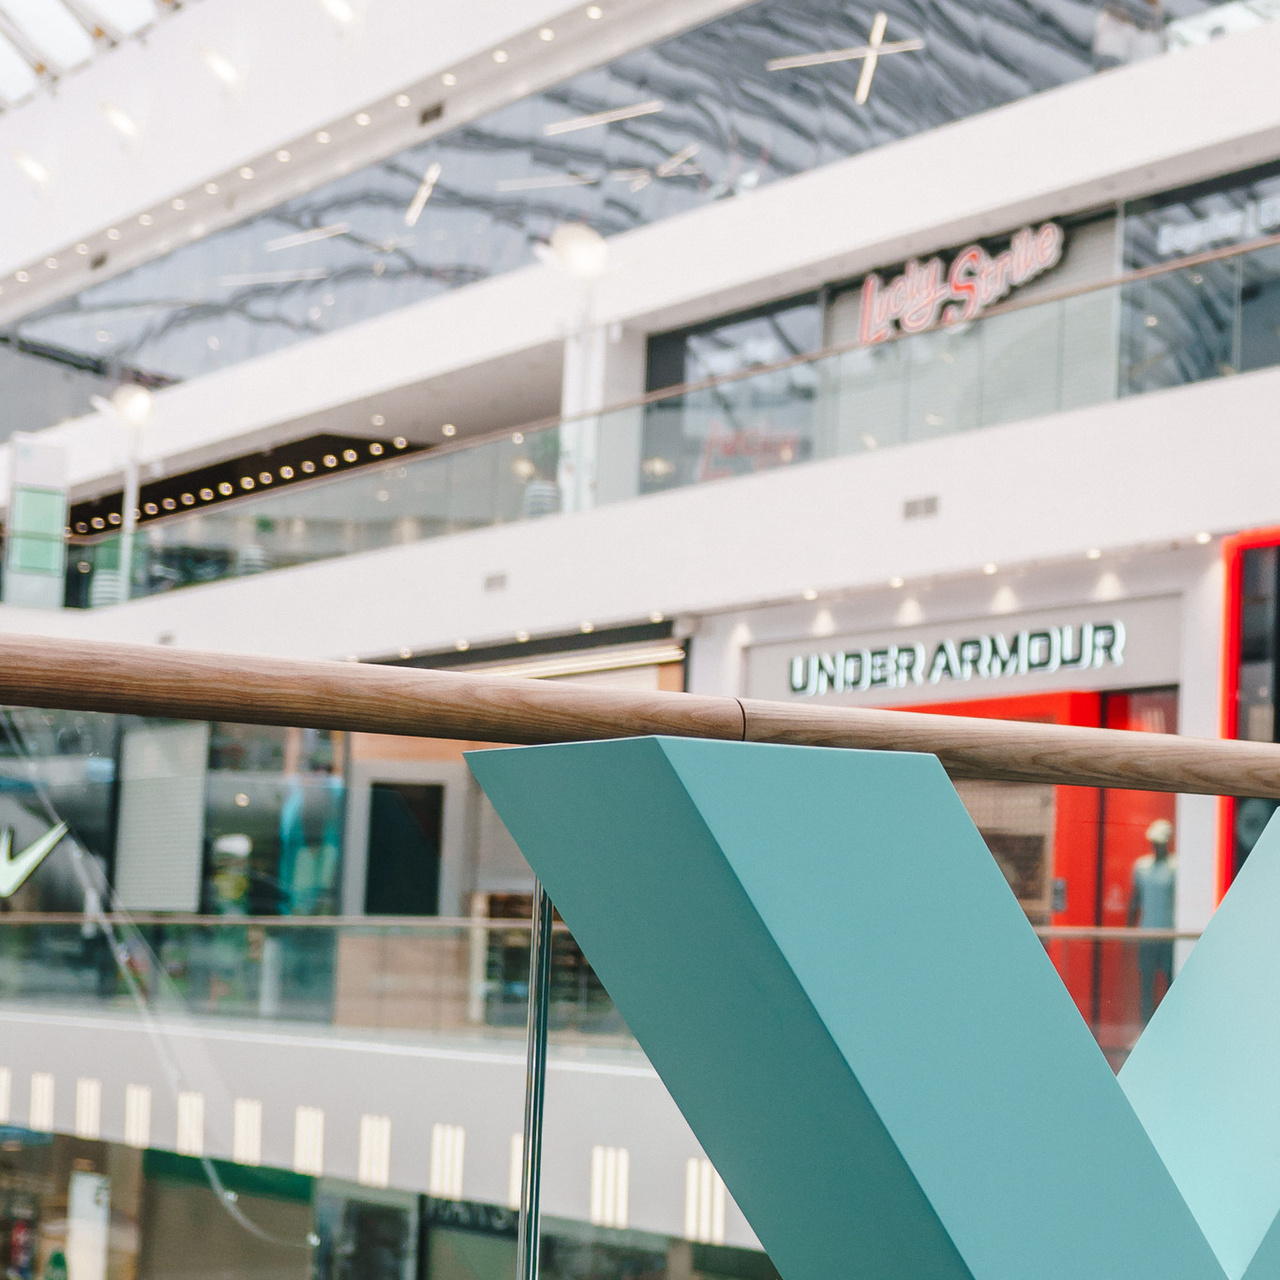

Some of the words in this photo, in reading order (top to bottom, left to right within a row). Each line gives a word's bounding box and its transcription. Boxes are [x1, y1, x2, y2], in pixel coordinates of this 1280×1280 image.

[860, 257, 949, 345] Lucky
[941, 222, 1065, 334] Strike
[791, 642, 926, 697] UNDER
[928, 619, 1127, 685] ARMOUR
